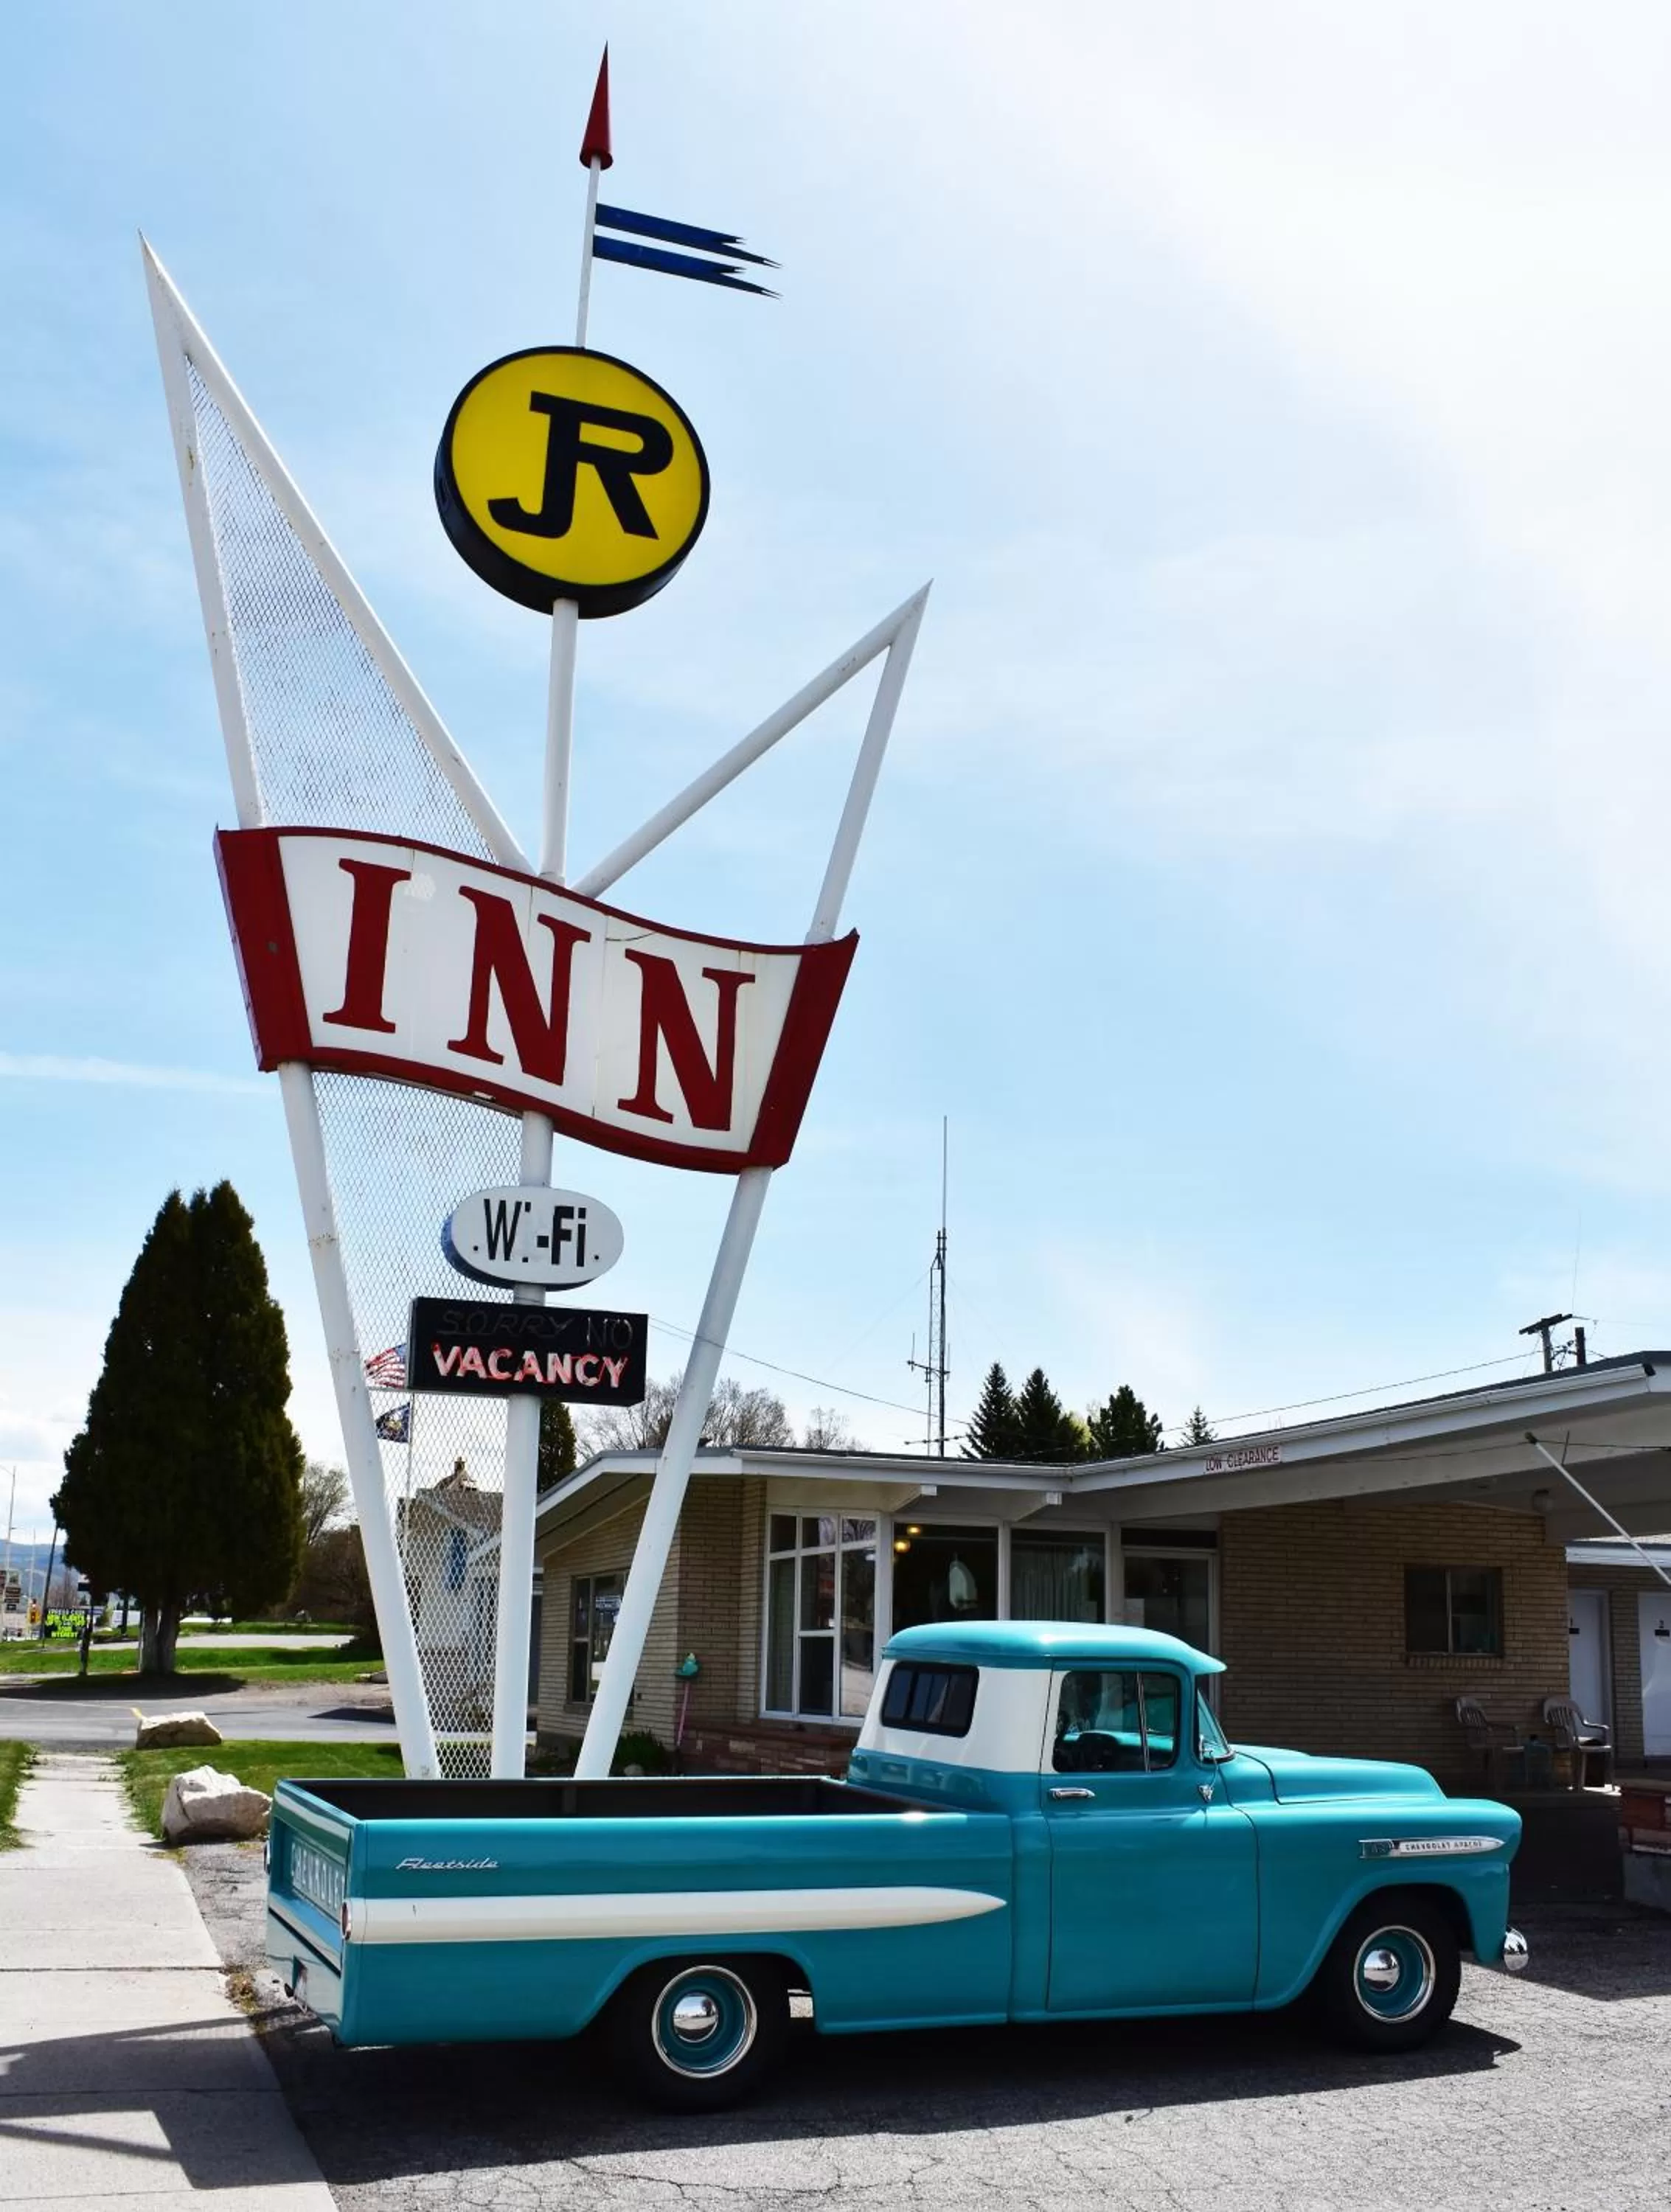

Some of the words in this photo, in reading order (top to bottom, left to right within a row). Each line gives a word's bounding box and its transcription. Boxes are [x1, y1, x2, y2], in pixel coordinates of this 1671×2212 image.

[487, 390, 674, 540] JR
[322, 858, 756, 1131] INN
[484, 1198, 587, 1267] W-Fi
[436, 1310, 574, 1338] SORRY
[586, 1317, 633, 1350] NO
[431, 1342, 628, 1388] VACANCY
[1206, 1457, 1222, 1471] LOW
[1227, 1447, 1279, 1468] CLEARANCE
[395, 1857, 499, 1870] Fleetside
